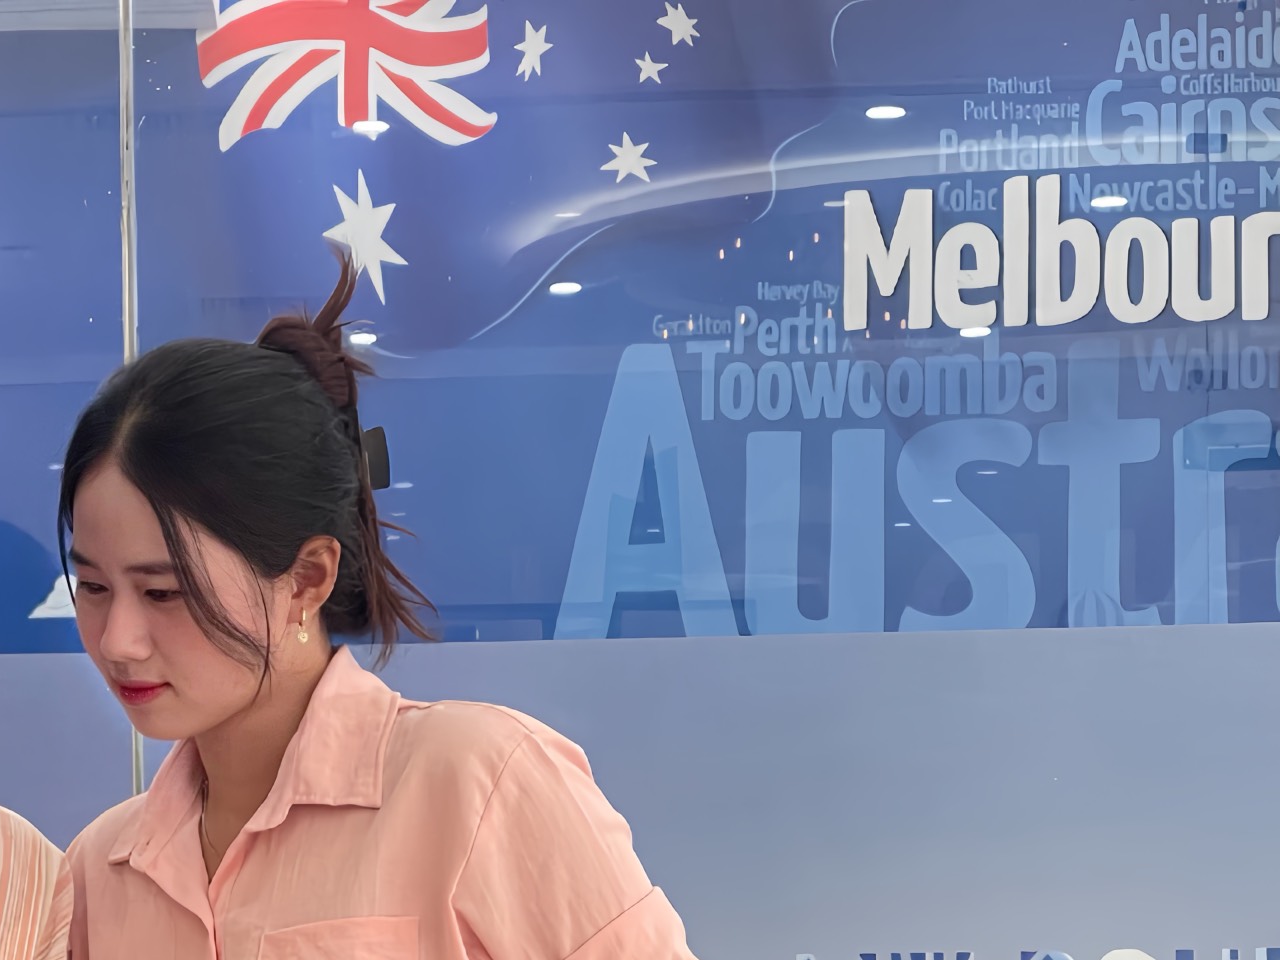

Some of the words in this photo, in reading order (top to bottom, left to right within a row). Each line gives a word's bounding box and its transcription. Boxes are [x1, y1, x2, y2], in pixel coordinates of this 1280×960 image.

[1115, 10, 1280, 73] Adelaid
[963, 99, 998, 121] Port
[987, 76, 1052, 94] Bathurst
[939, 121, 1079, 173] Portland
[1086, 74, 1280, 166] Cairns
[938, 179, 998, 212] Colac
[843, 173, 1280, 331] Melbour
[733, 302, 837, 357] Perth
[686, 328, 1057, 421] Toowoomba
[553, 335, 1280, 640] Austr
